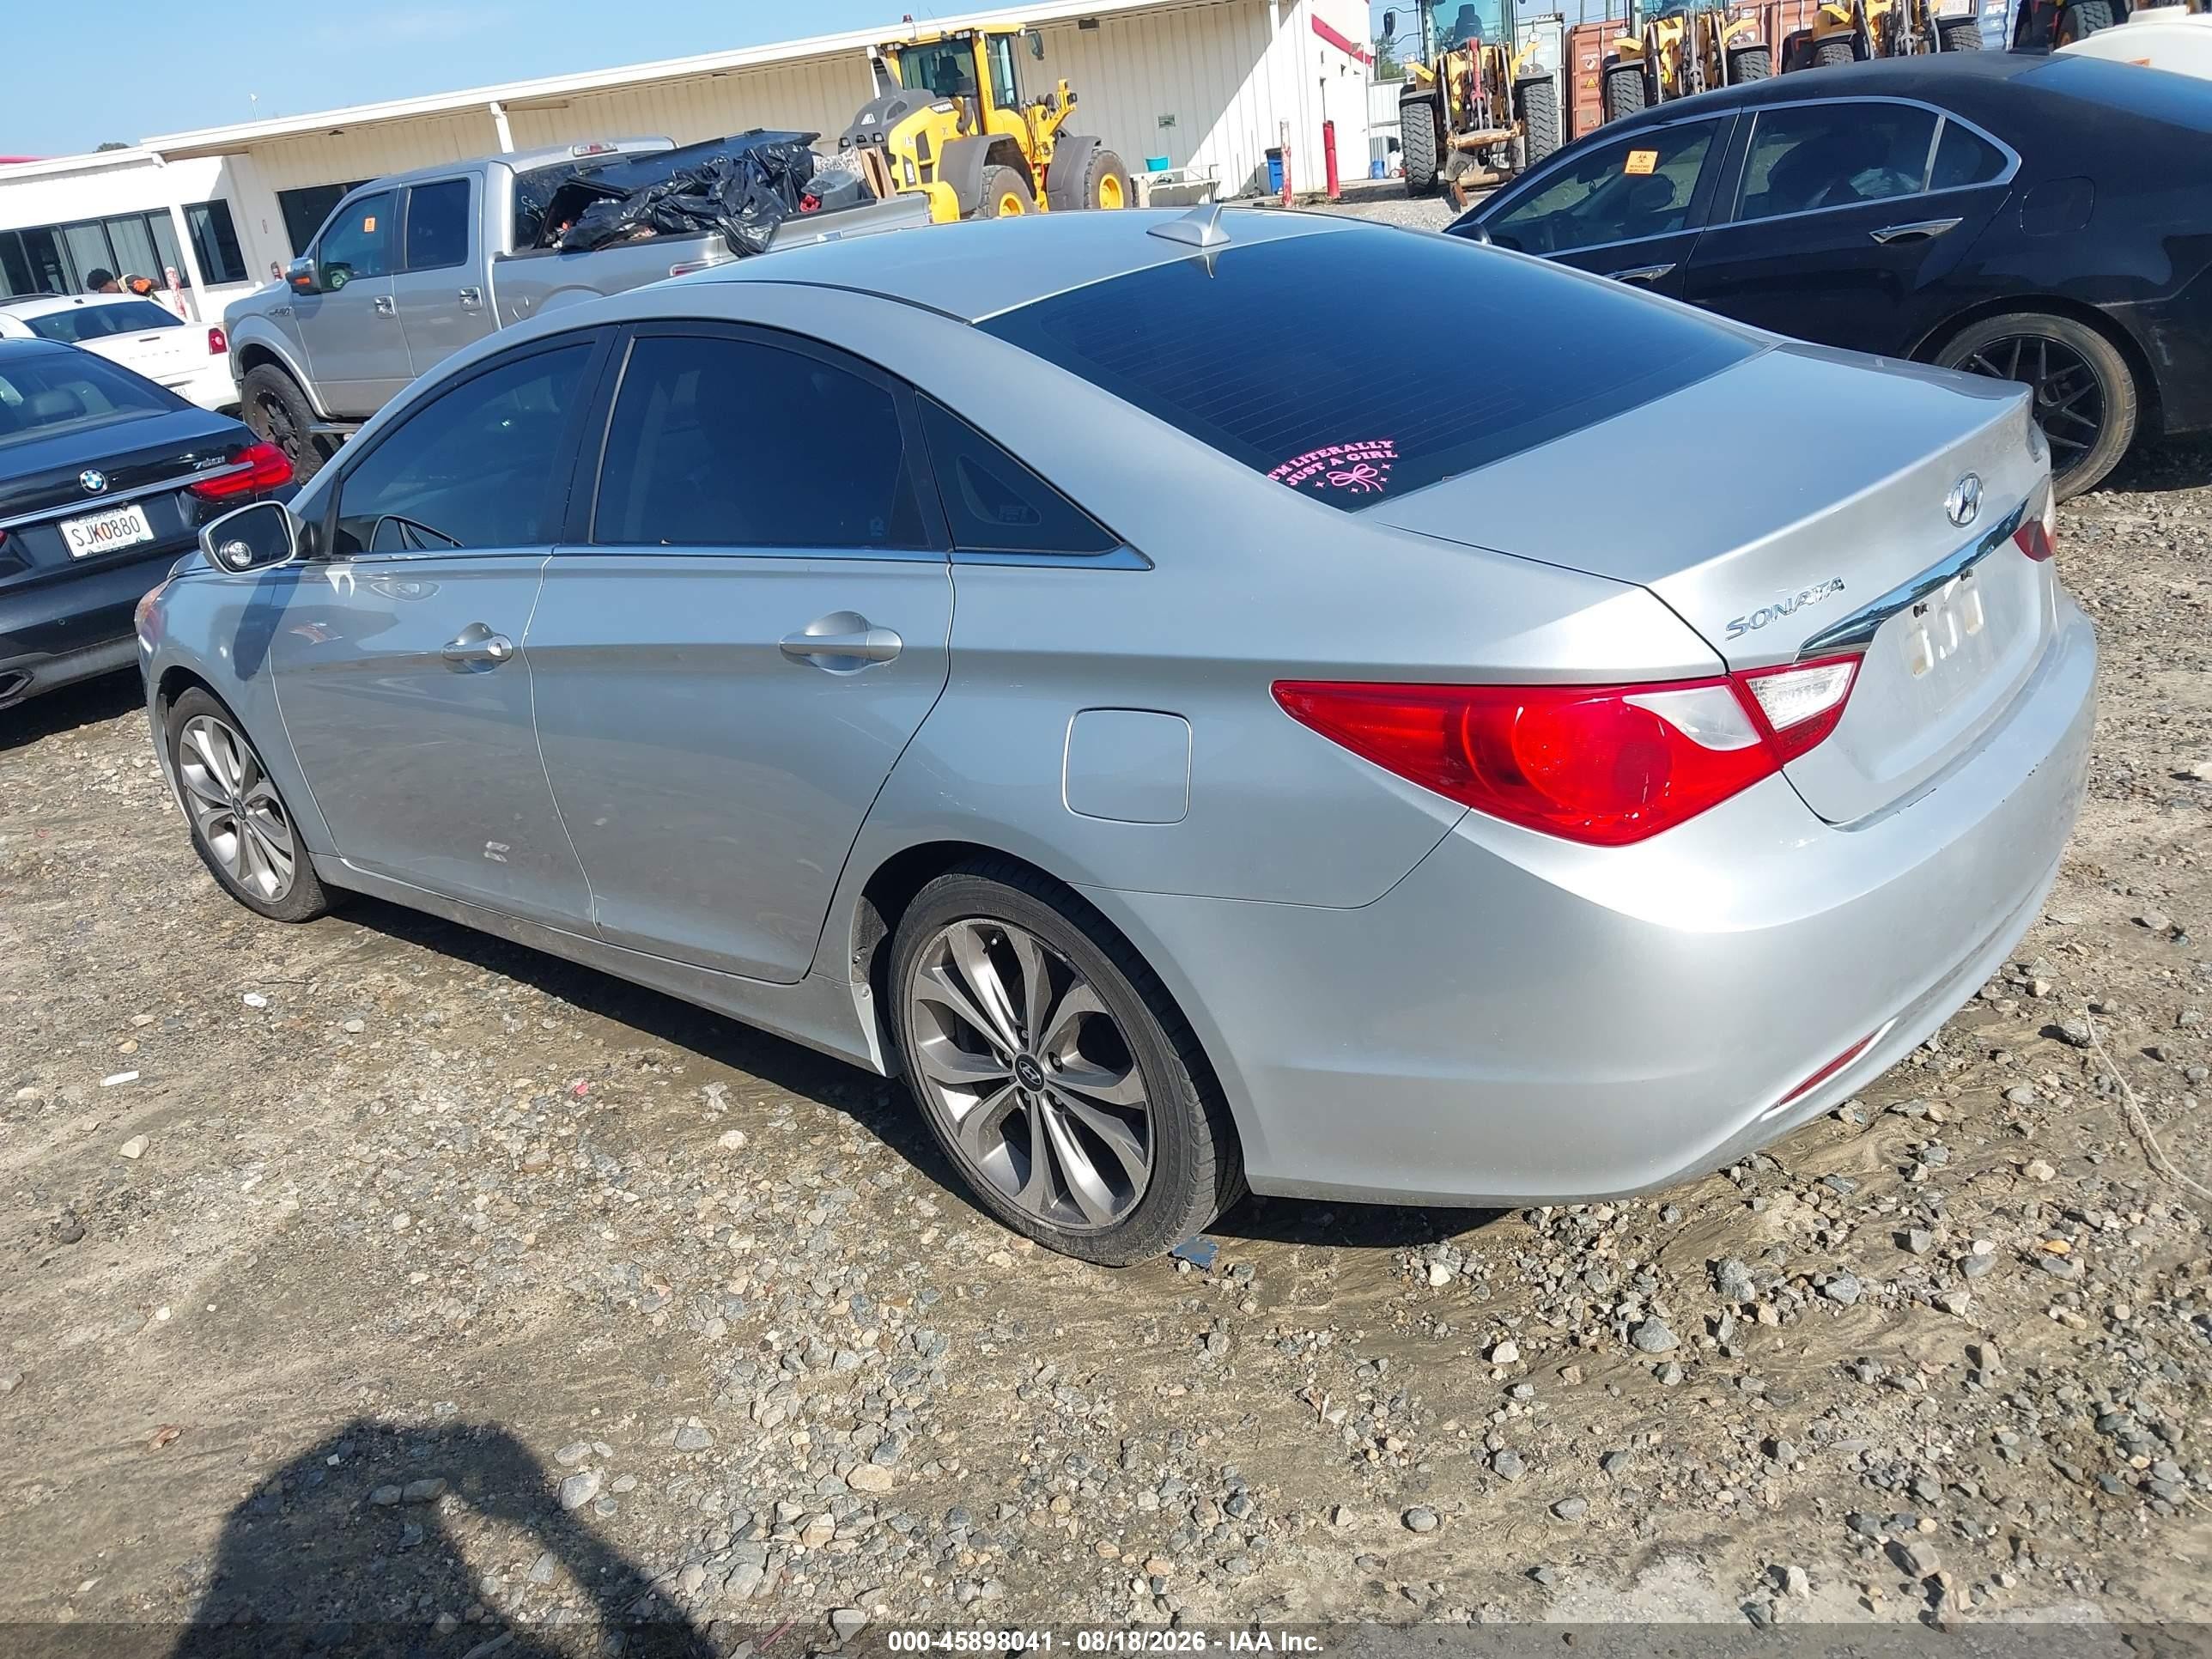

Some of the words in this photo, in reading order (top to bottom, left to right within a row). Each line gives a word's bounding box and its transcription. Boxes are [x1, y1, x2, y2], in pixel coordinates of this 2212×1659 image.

[1267, 464, 1293, 481] I'M
[1289, 441, 1394, 468] LITERALLY
[1286, 461, 1326, 486] JUST
[1329, 458, 1345, 466] A
[1346, 450, 1398, 461] GIRL
[71, 515, 141, 547] SJK0880
[1725, 577, 1845, 641] SONATA
